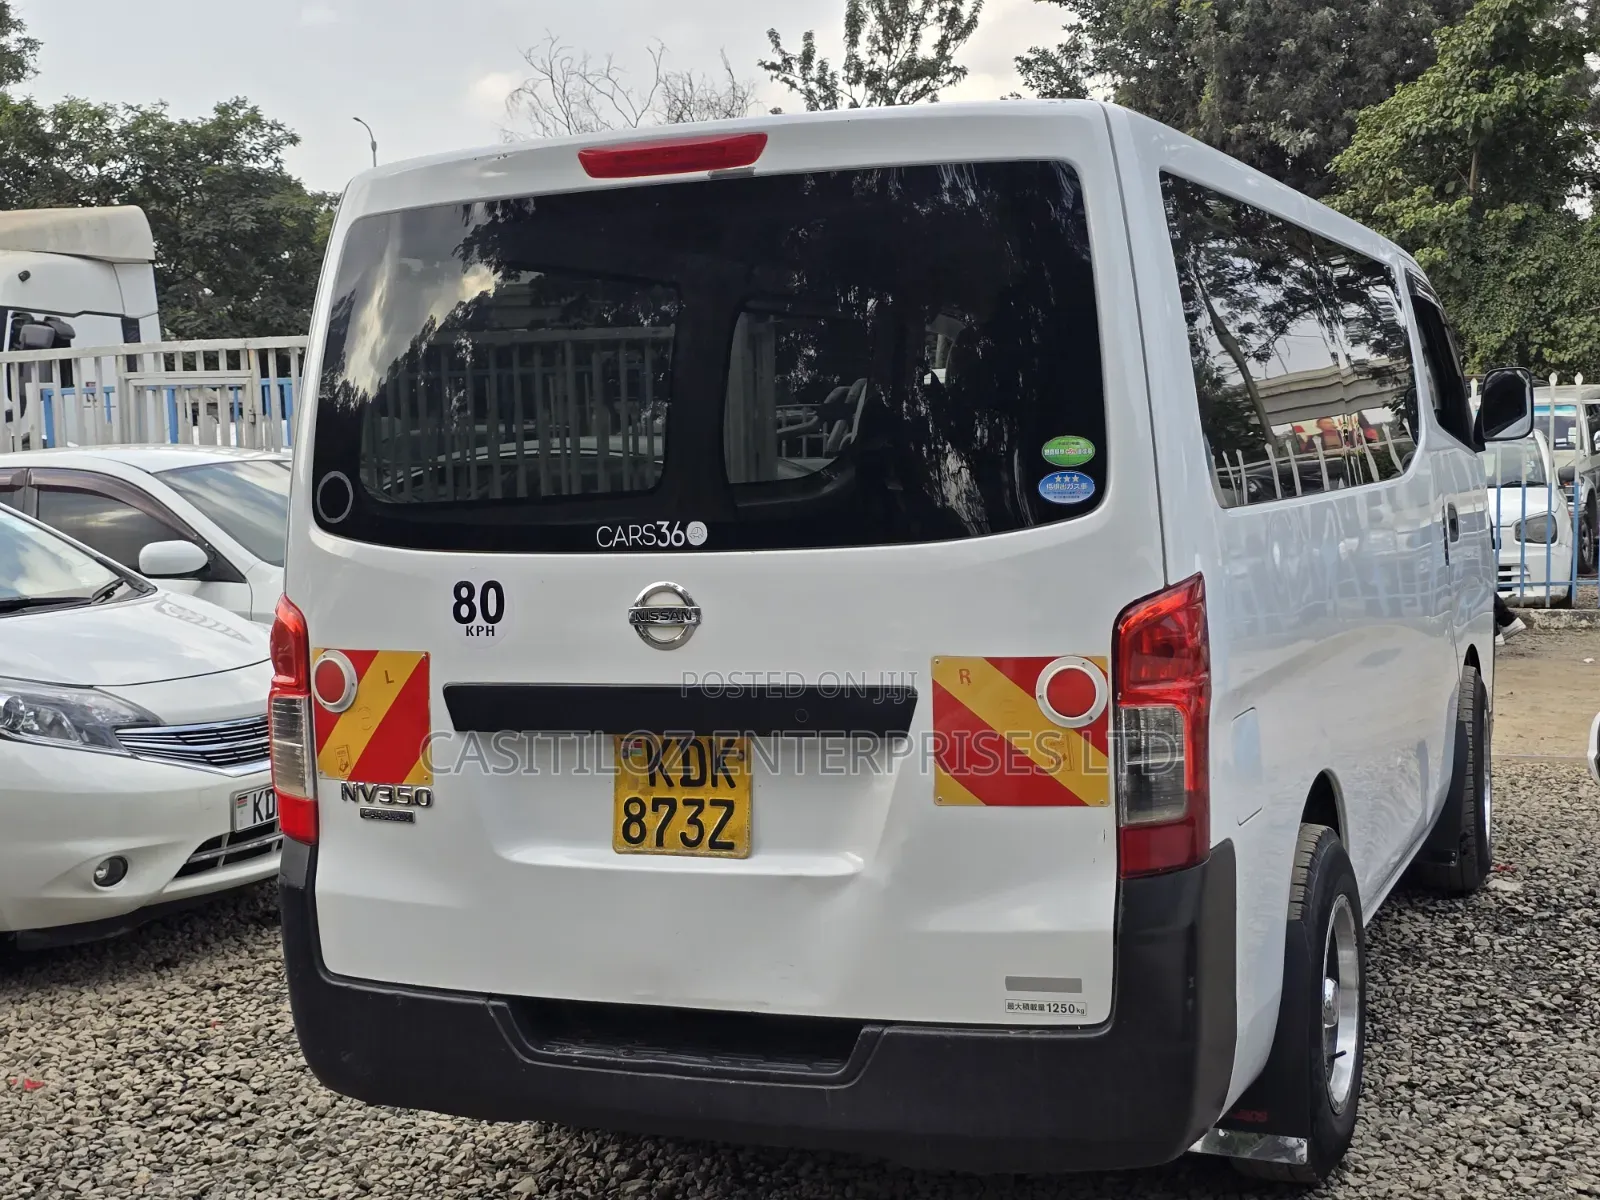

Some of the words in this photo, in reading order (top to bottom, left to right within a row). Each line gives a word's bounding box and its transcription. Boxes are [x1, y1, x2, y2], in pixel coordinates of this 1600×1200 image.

[452, 580, 505, 624] 80
[634, 611, 693, 621] NISSAN
[465, 625, 495, 637] KPH
[384, 670, 395, 684] L
[958, 668, 972, 685] R
[644, 737, 737, 788] KDK
[252, 788, 279, 825] KD
[340, 780, 434, 808] NV350
[622, 796, 735, 850] 873Z
